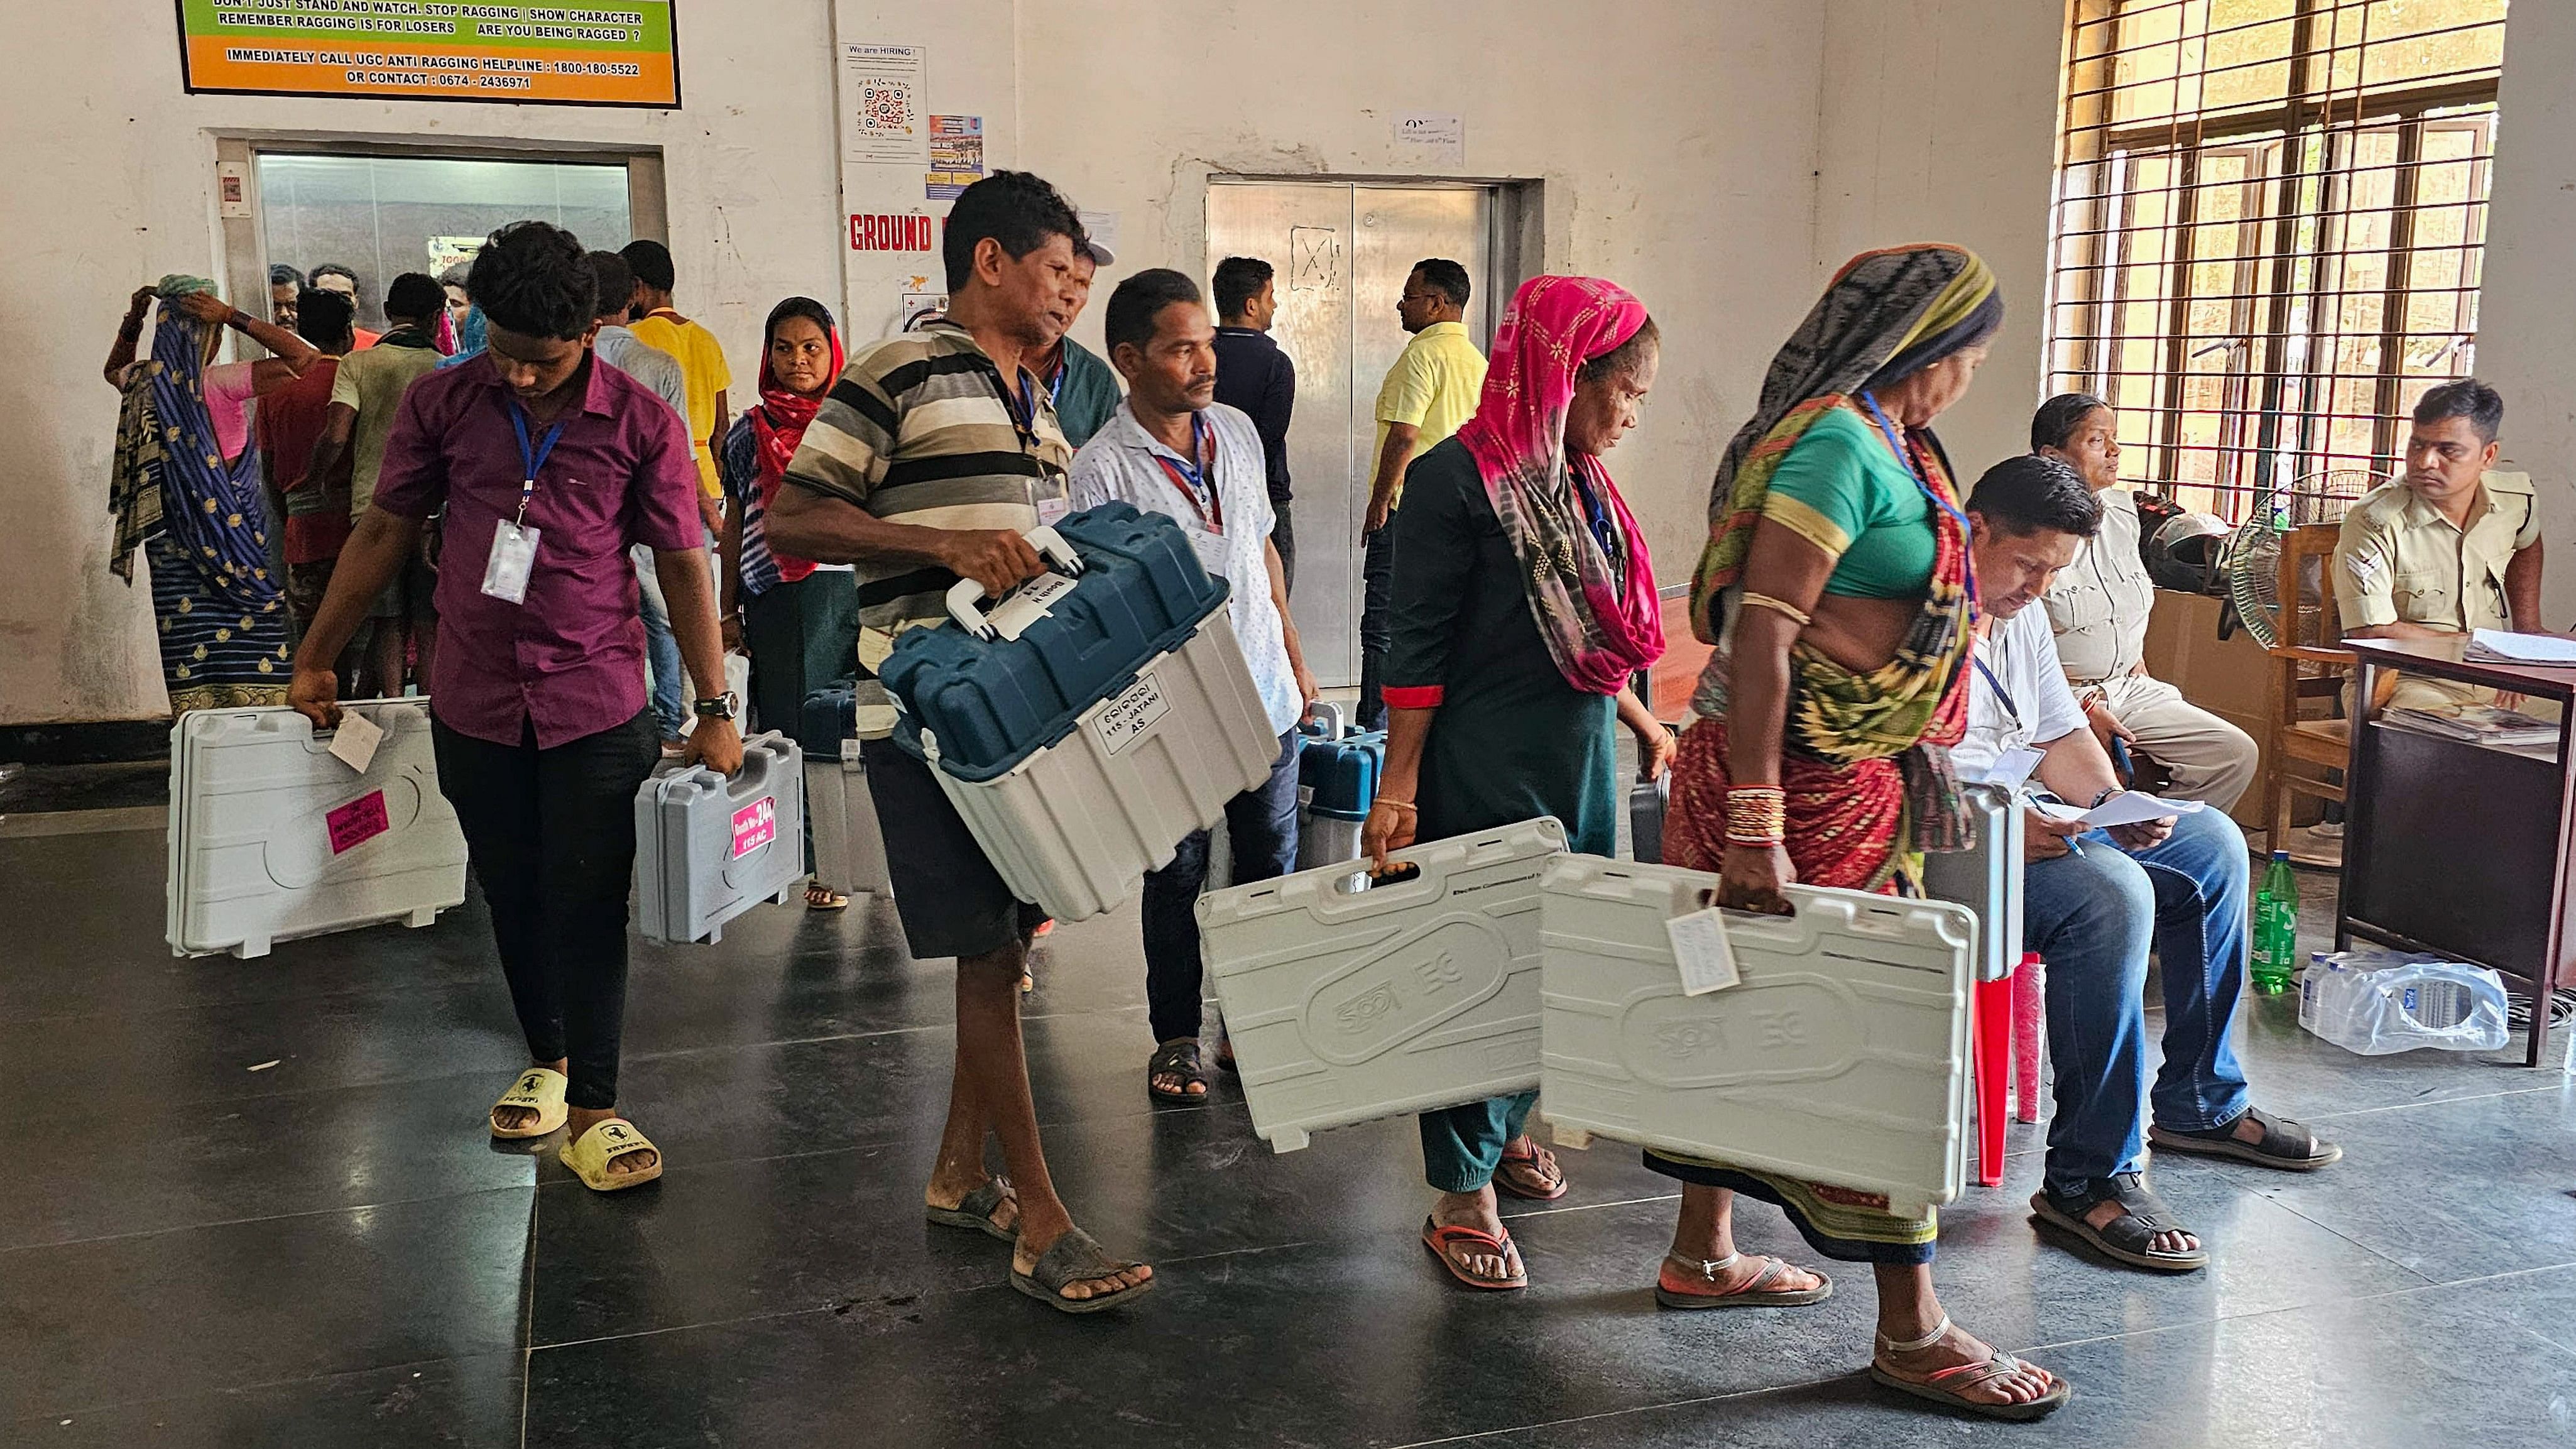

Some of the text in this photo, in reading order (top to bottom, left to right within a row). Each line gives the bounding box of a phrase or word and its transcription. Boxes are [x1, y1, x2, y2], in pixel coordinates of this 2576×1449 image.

[259, 0, 290, 8] JUST
[296, 0, 338, 10] STAND
[342, 1, 369, 12] AND
[373, 3, 421, 14] WATCH.
[425, 4, 457, 16] STOP
[462, 6, 518, 18] RAGGING
[530, 9, 565, 21] SHOW
[569, 11, 642, 24] CHARACTER
[219, 13, 454, 33] REMEMBER RAGGING IS FOR LOSERS
[478, 24, 640, 40] ARE YOU BEING RAGGED ?
[849, 45, 861, 53] We
[880, 47, 911, 55] HIRING
[227, 49, 315, 63] IMMEDIATELY
[320, 53, 352, 64] CALL
[356, 54, 383, 65] UGC
[388, 56, 417, 67] ANTI
[422, 57, 479, 69] RAGGING
[483, 59, 543, 72] HELPLINE
[554, 63, 638, 75] 1800-180-5522
[347, 72, 365, 82] OR
[369, 72, 427, 84] CONTACT
[439, 75, 469, 85] 0674
[480, 76, 529, 88] 2436971
[850, 214, 932, 251] GROUND
[1039, 581, 1065, 598] Booth
[1106, 722, 1122, 736] 115
[1129, 692, 1159, 719] JATANI
[1132, 718, 1145, 734] AS
